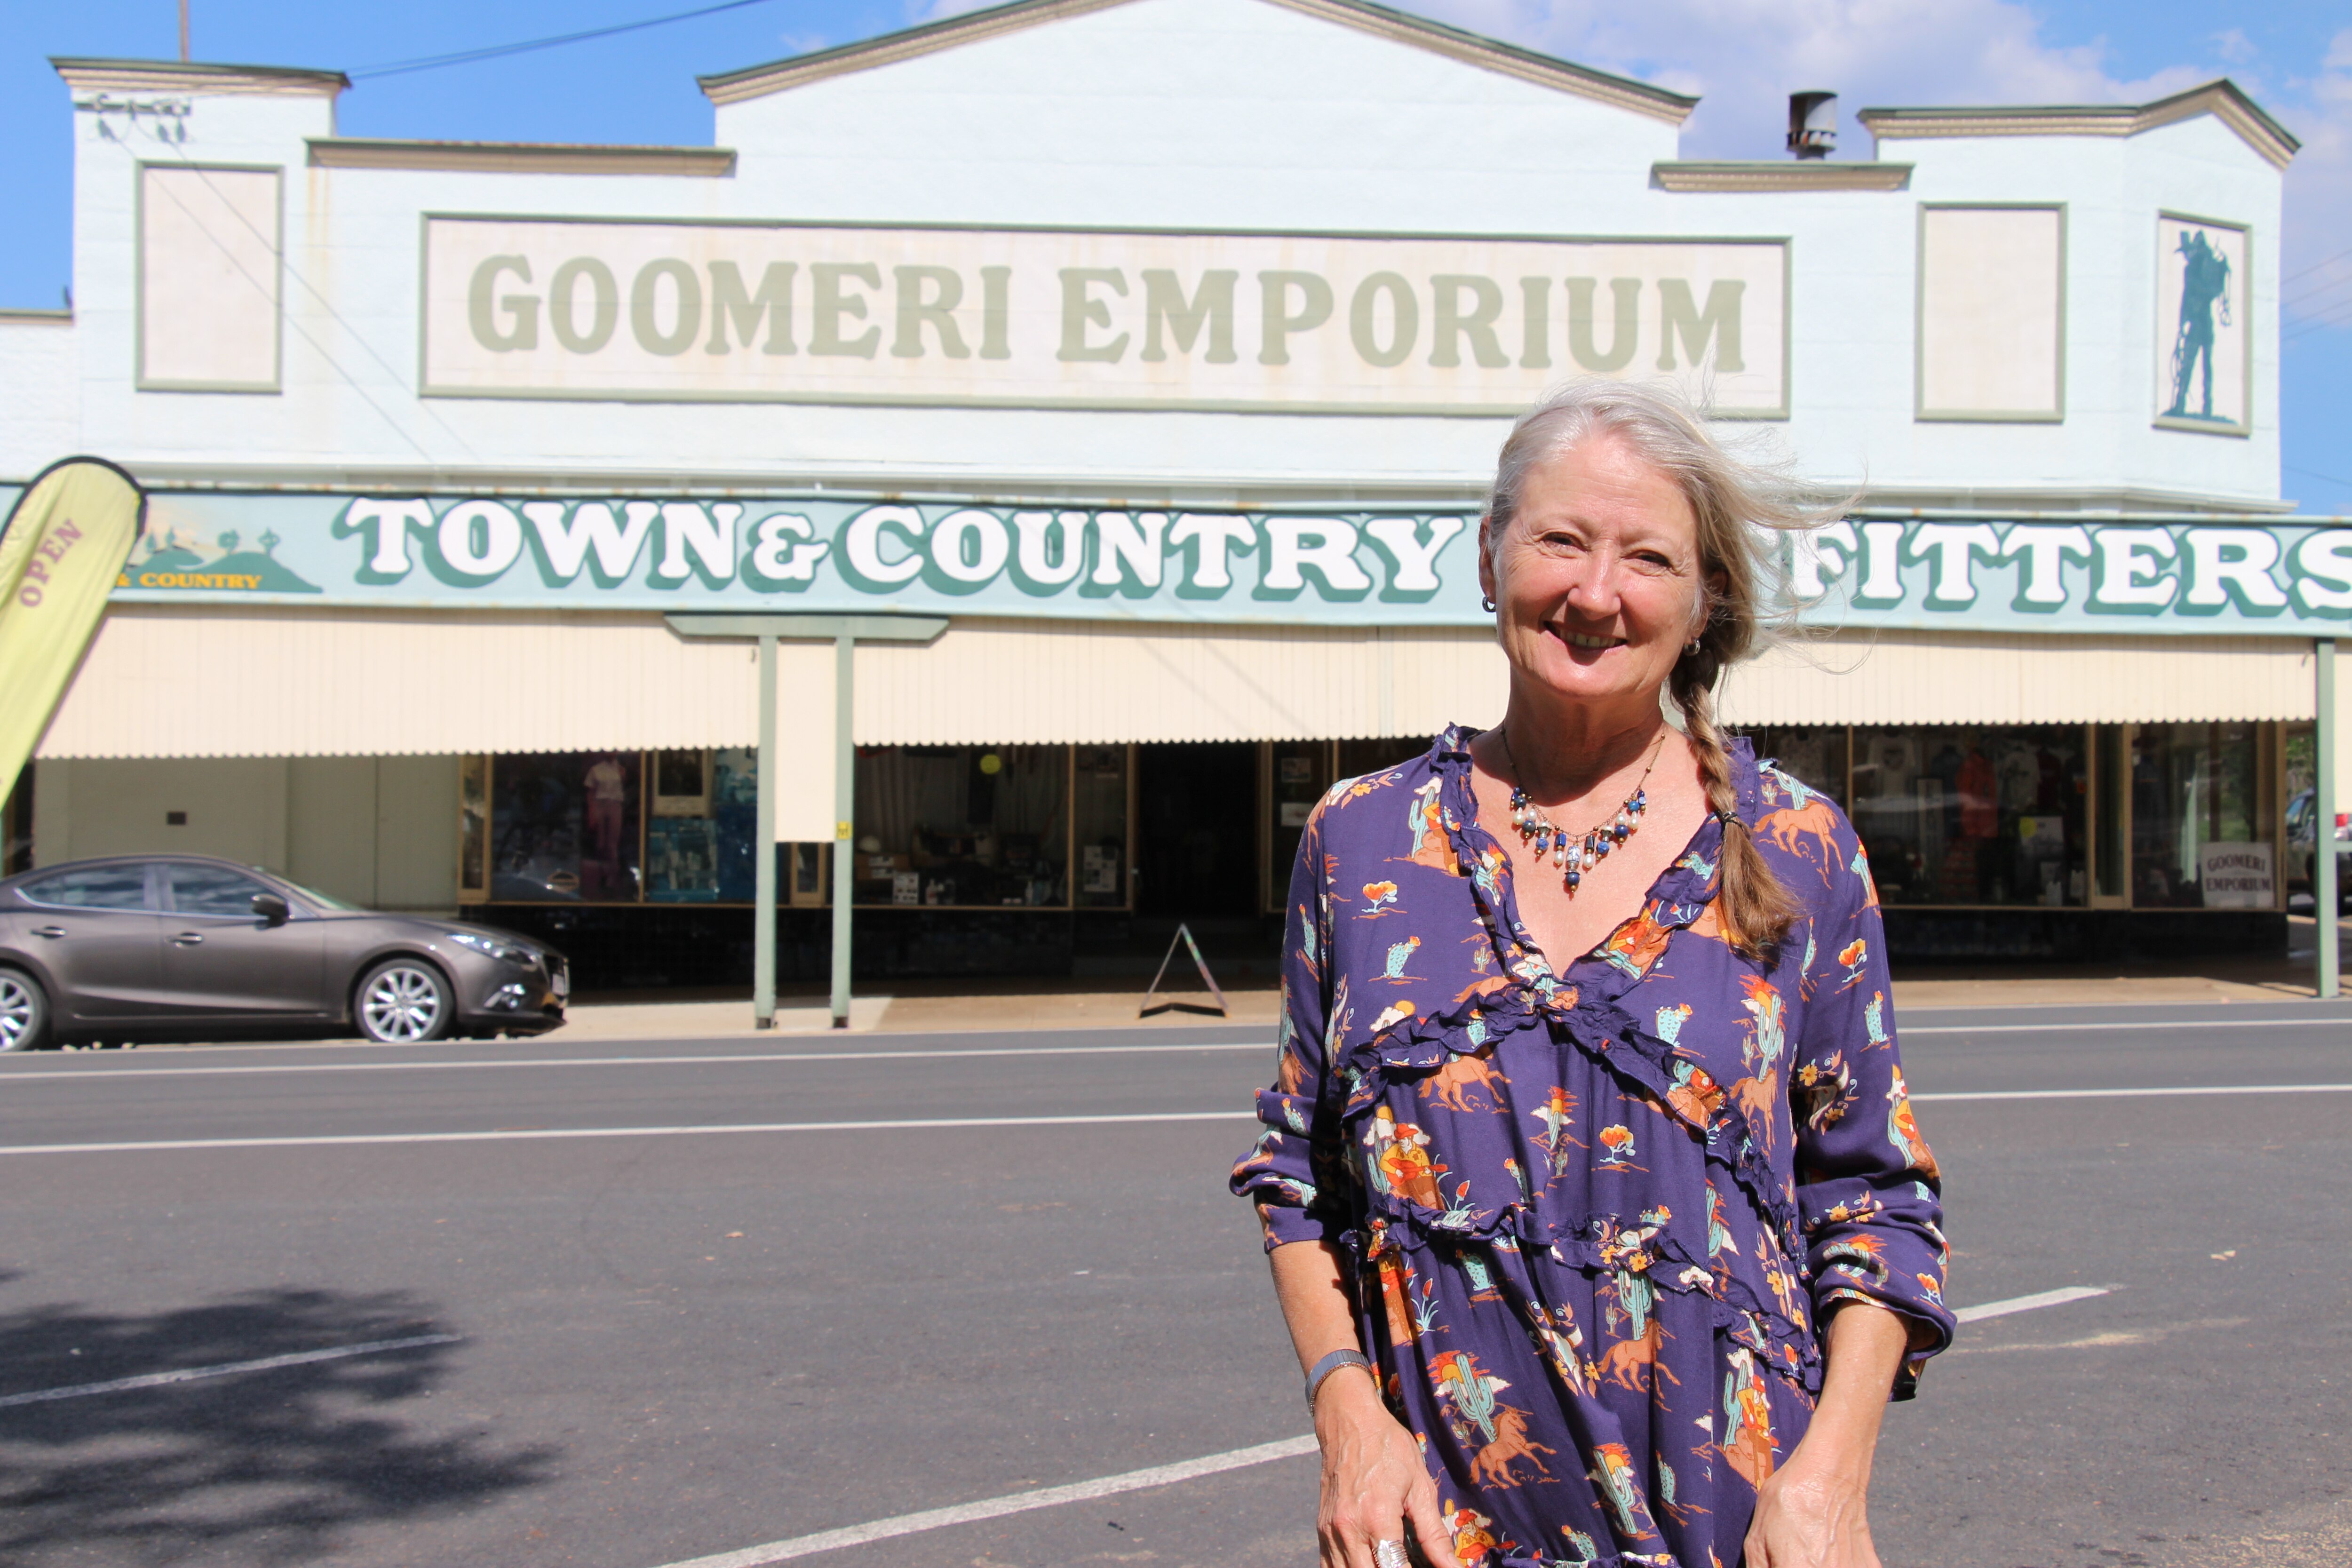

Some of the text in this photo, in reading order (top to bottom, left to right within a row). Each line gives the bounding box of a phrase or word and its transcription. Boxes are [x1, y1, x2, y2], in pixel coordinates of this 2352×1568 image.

[468, 253, 1747, 373] GOOMERI EMPORIUM
[19, 518, 83, 607] OPEN
[139, 572, 262, 589] COUNTRY
[342, 497, 744, 581] TOWN
[842, 503, 1465, 592] COUNTRY
